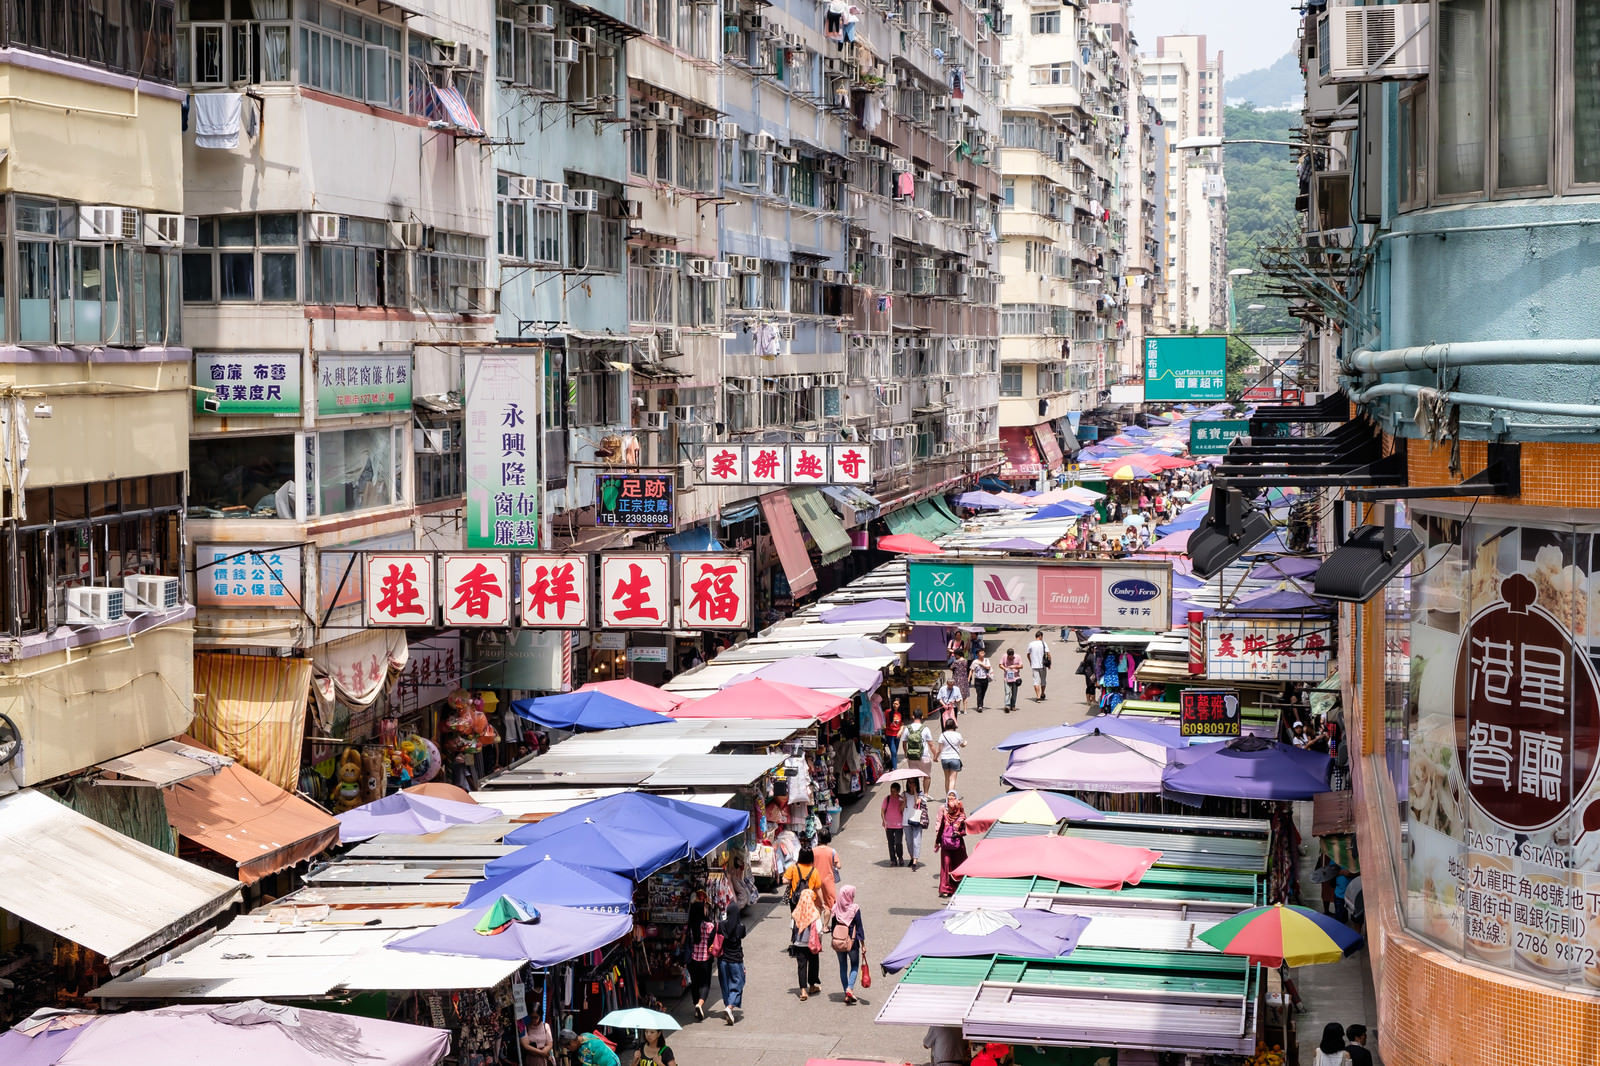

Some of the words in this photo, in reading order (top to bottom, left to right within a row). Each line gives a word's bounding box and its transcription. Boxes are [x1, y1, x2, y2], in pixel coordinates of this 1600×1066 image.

[210, 363, 242, 381] 窗簾
[253, 363, 287, 381] 布藝
[321, 364, 407, 387] 永興隆窗簾布藝
[215, 385, 282, 401] 專業度尺
[501, 403, 526, 487] 永興隆
[621, 479, 666, 498] 足跡
[619, 499, 668, 513] 正宗按摩
[214, 569, 284, 581] 價錢公道
[214, 584, 284, 596] 信心保證
[1114, 586, 1135, 597] Embry
[1138, 587, 1156, 597] Form
[1050, 591, 1089, 605] Triumph
[982, 602, 1028, 615] Wacoal
[1117, 607, 1151, 616] 安莉芳
[1183, 723, 1239, 734] 60980978
[1467, 831, 1516, 856] TASTY
[1522, 844, 1565, 869] STAR
[1516, 931, 1548, 955] 2786
[1555, 942, 1595, 965] 9872
